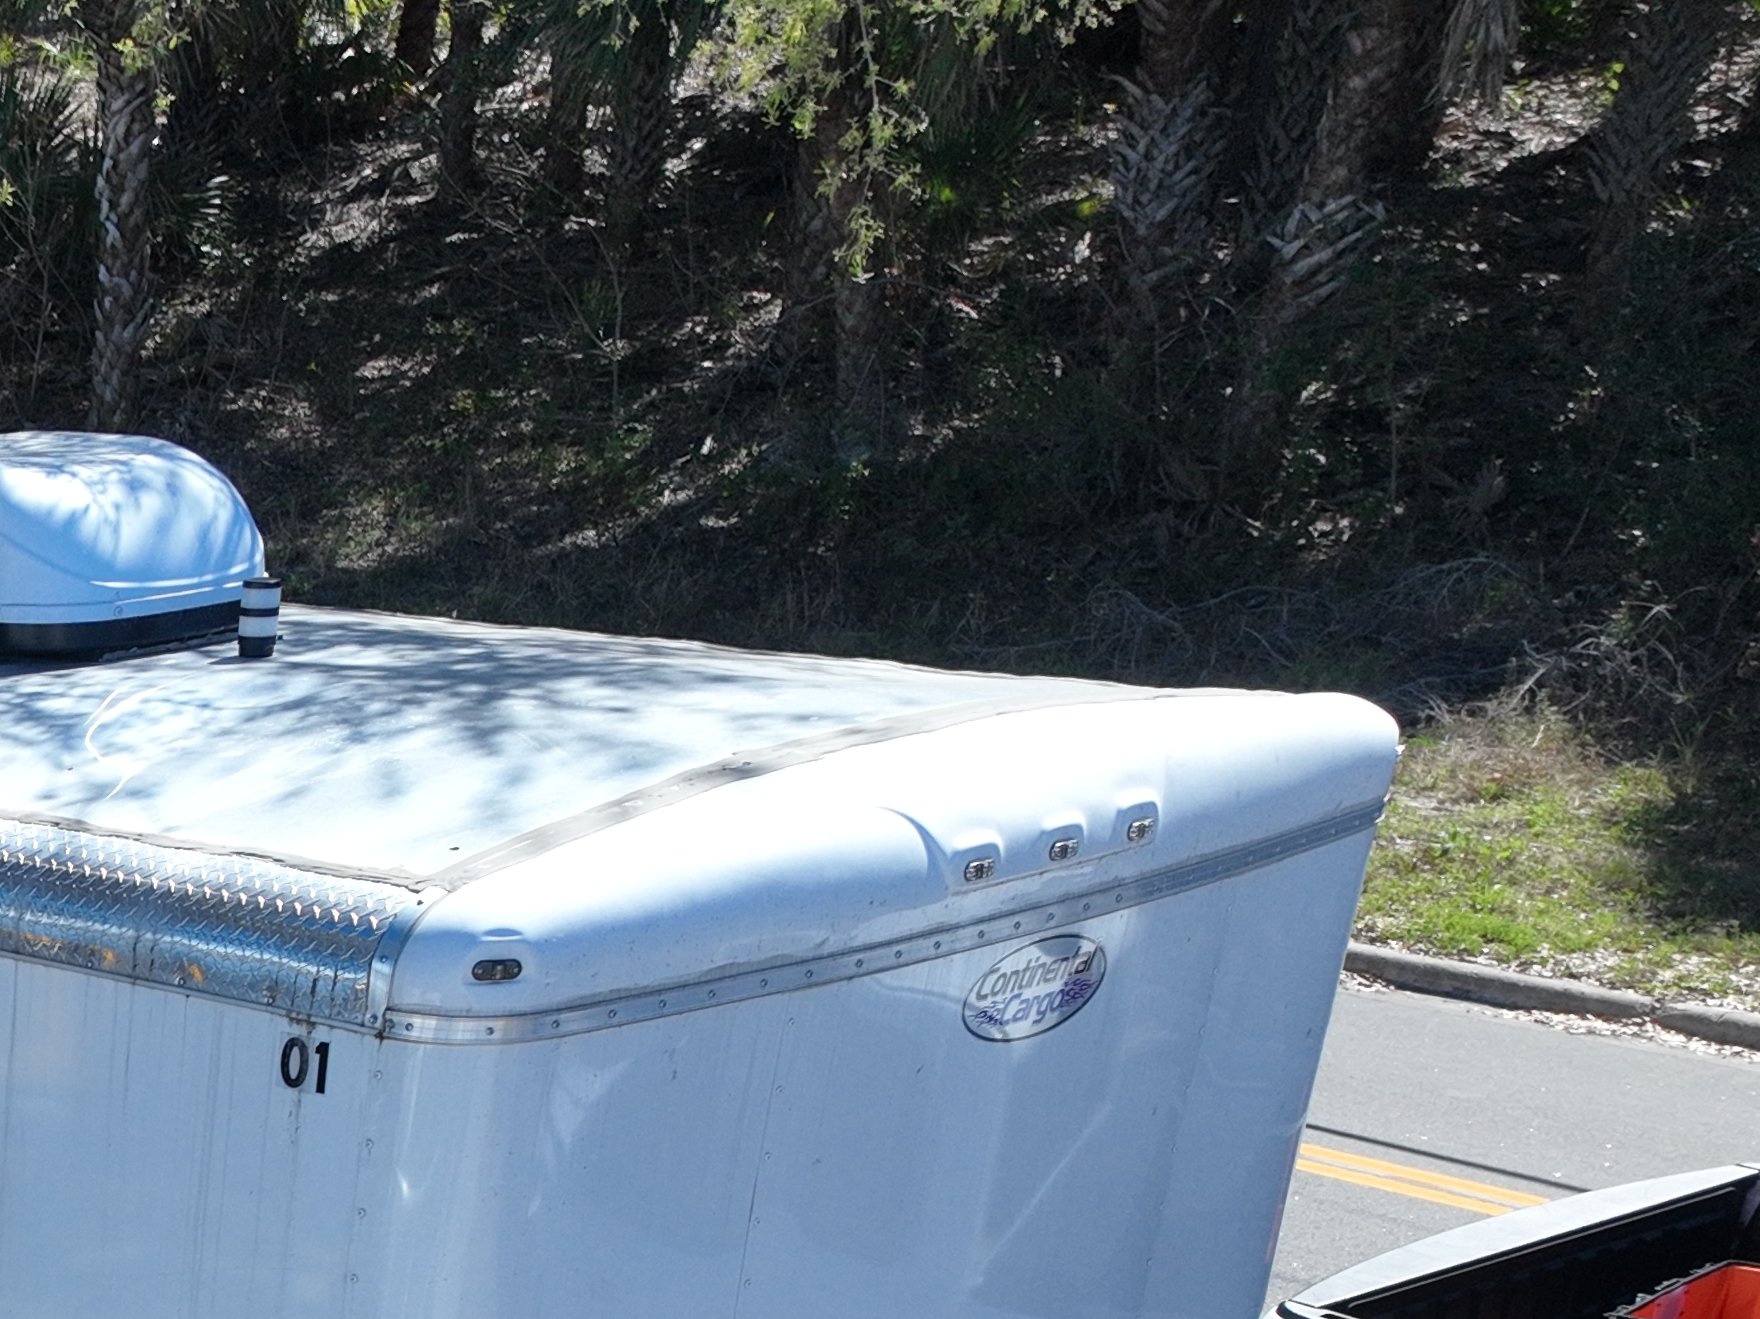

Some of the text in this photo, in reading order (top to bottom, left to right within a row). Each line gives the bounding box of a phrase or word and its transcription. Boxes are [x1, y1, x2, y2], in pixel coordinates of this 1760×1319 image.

[975, 942, 1099, 1001] Continental
[1000, 986, 1065, 1026] Cargo
[280, 1036, 330, 1094] 01
